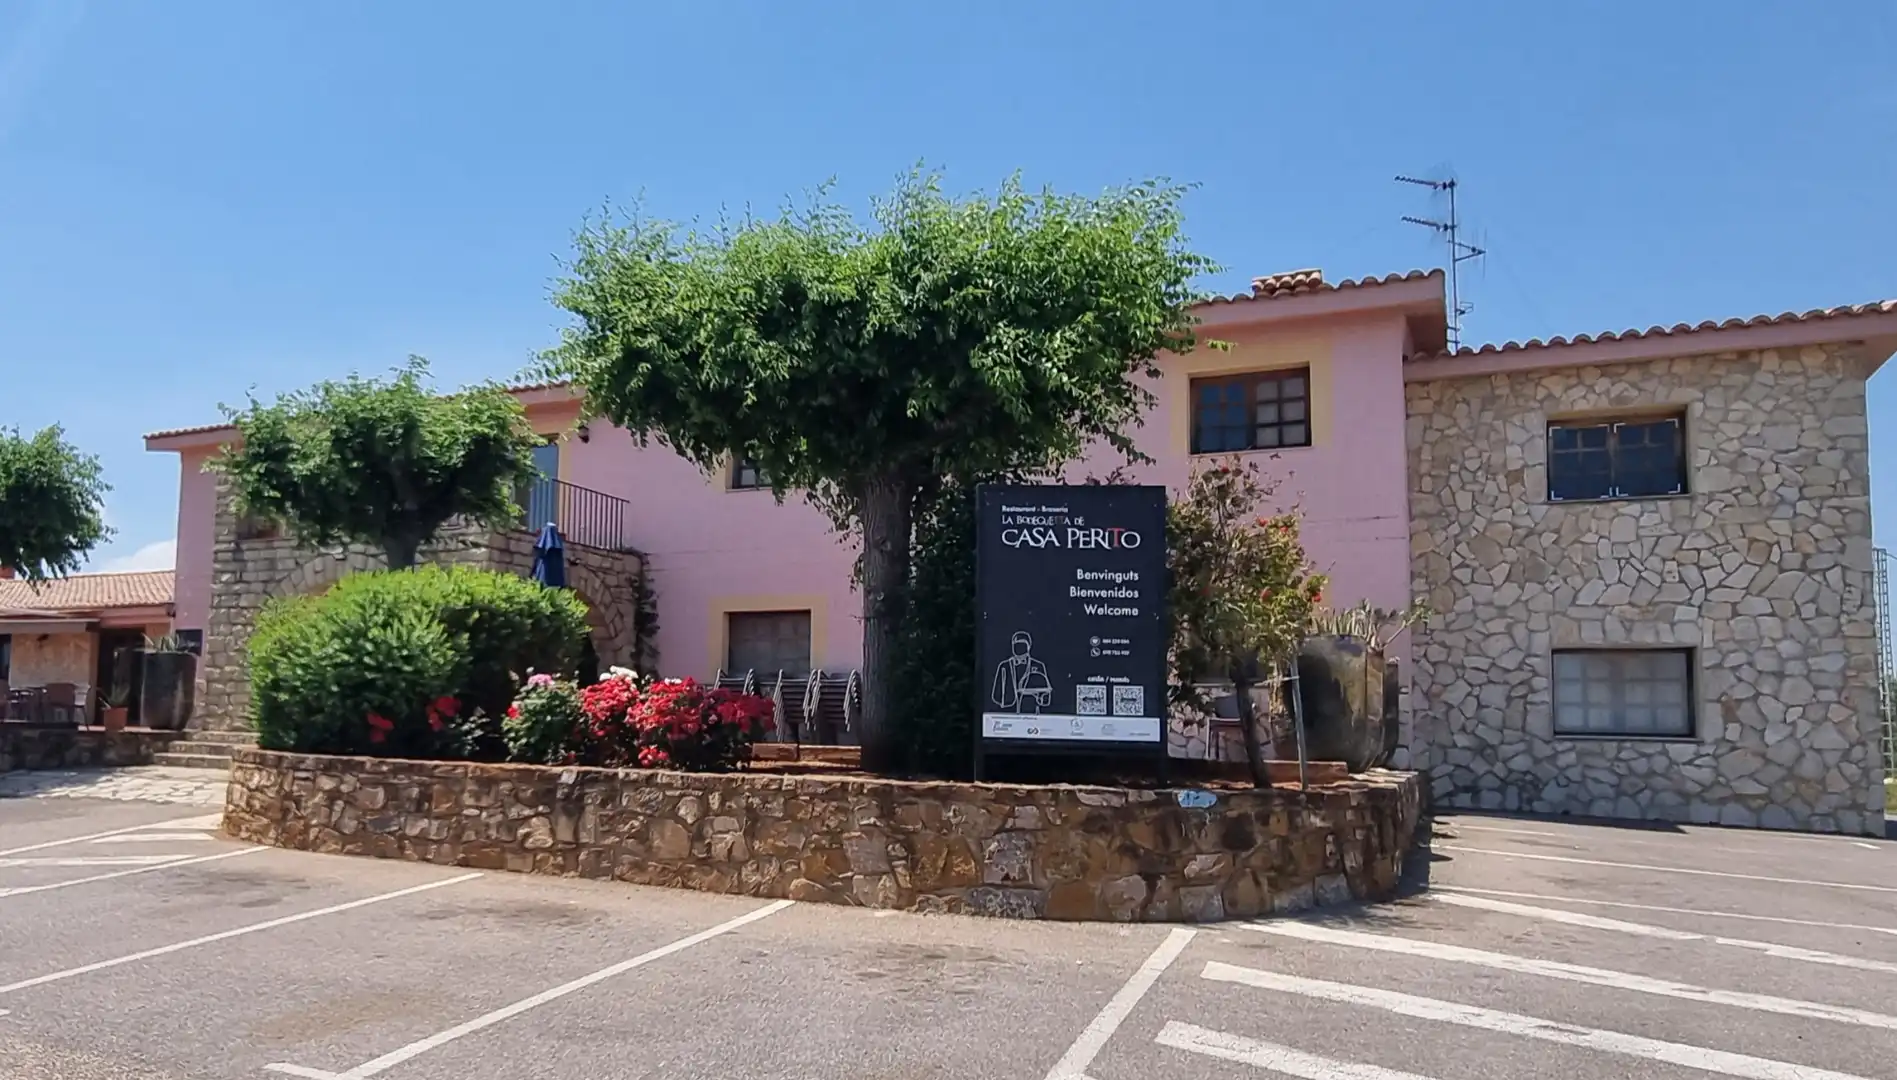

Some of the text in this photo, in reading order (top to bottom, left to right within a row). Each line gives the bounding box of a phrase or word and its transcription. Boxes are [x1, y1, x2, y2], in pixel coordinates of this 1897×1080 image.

[1002, 515, 1013, 525] LA
[1074, 516, 1085, 526] DE
[1001, 527, 1141, 550] CASA PERITO
[1076, 568, 1139, 584] Benvinguts
[1069, 586, 1139, 598] Bienvenidos
[1083, 603, 1139, 616] Welcome
